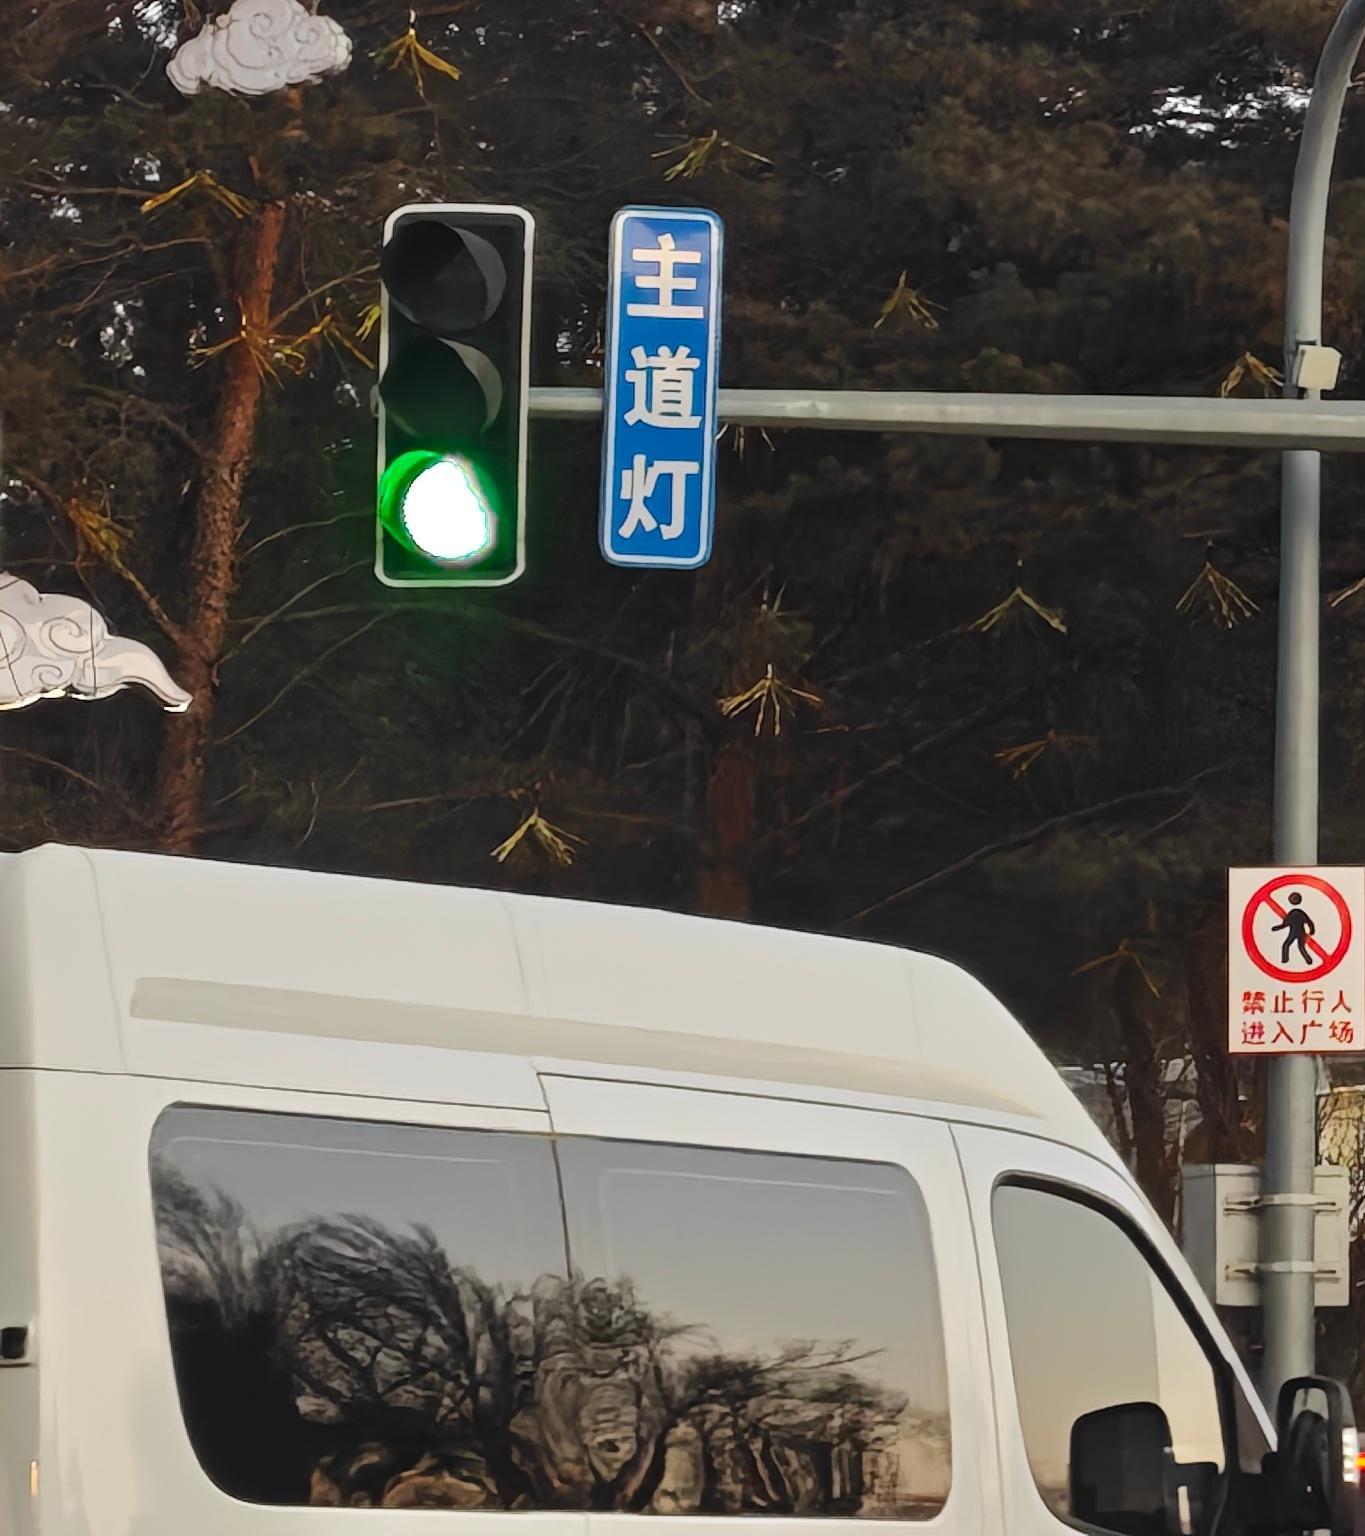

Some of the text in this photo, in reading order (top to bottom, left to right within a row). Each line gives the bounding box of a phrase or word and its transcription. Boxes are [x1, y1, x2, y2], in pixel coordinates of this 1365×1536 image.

[616, 232, 706, 541] 主道灯
[1241, 989, 1353, 1014] 禁止行人
[1241, 1020, 1354, 1044] 进入广场
